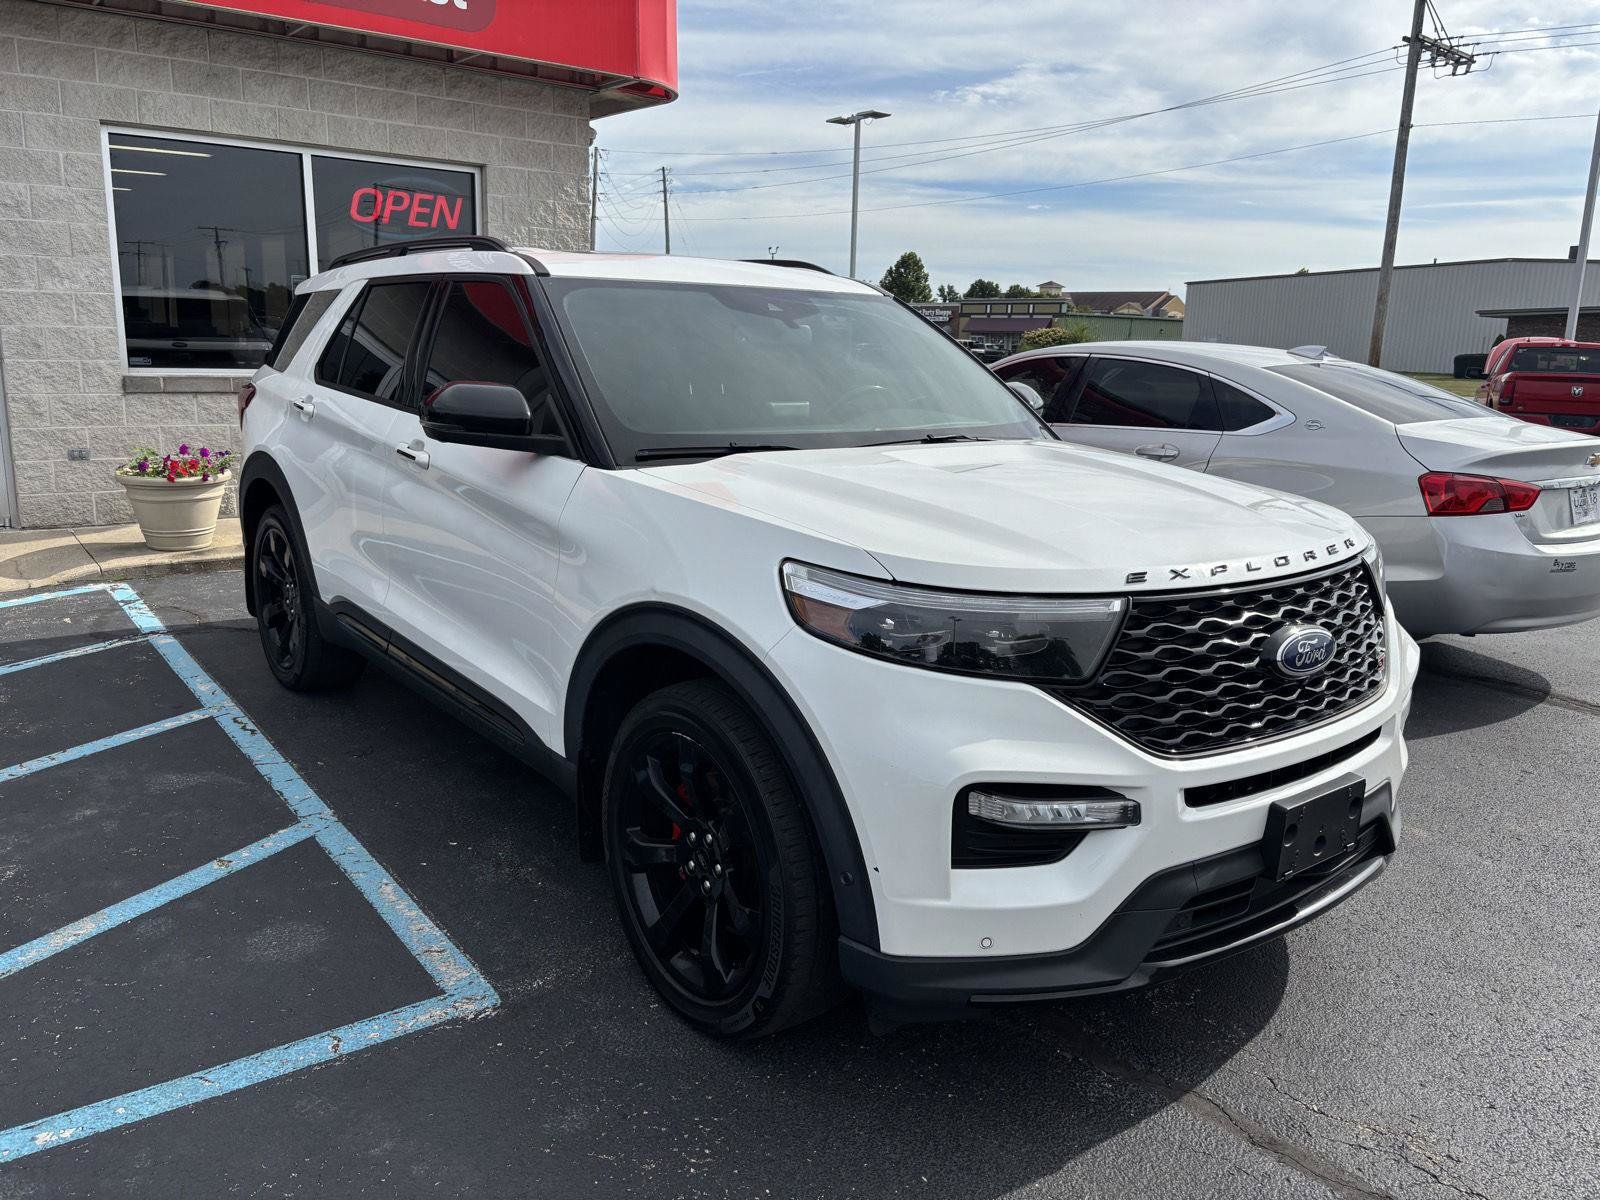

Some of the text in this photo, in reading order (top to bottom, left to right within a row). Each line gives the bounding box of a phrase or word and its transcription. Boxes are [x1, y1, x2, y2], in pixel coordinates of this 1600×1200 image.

[350, 187, 463, 230] OPEN
[1125, 538, 1356, 584] EXPLORER
[1295, 638, 1327, 667] Ford
